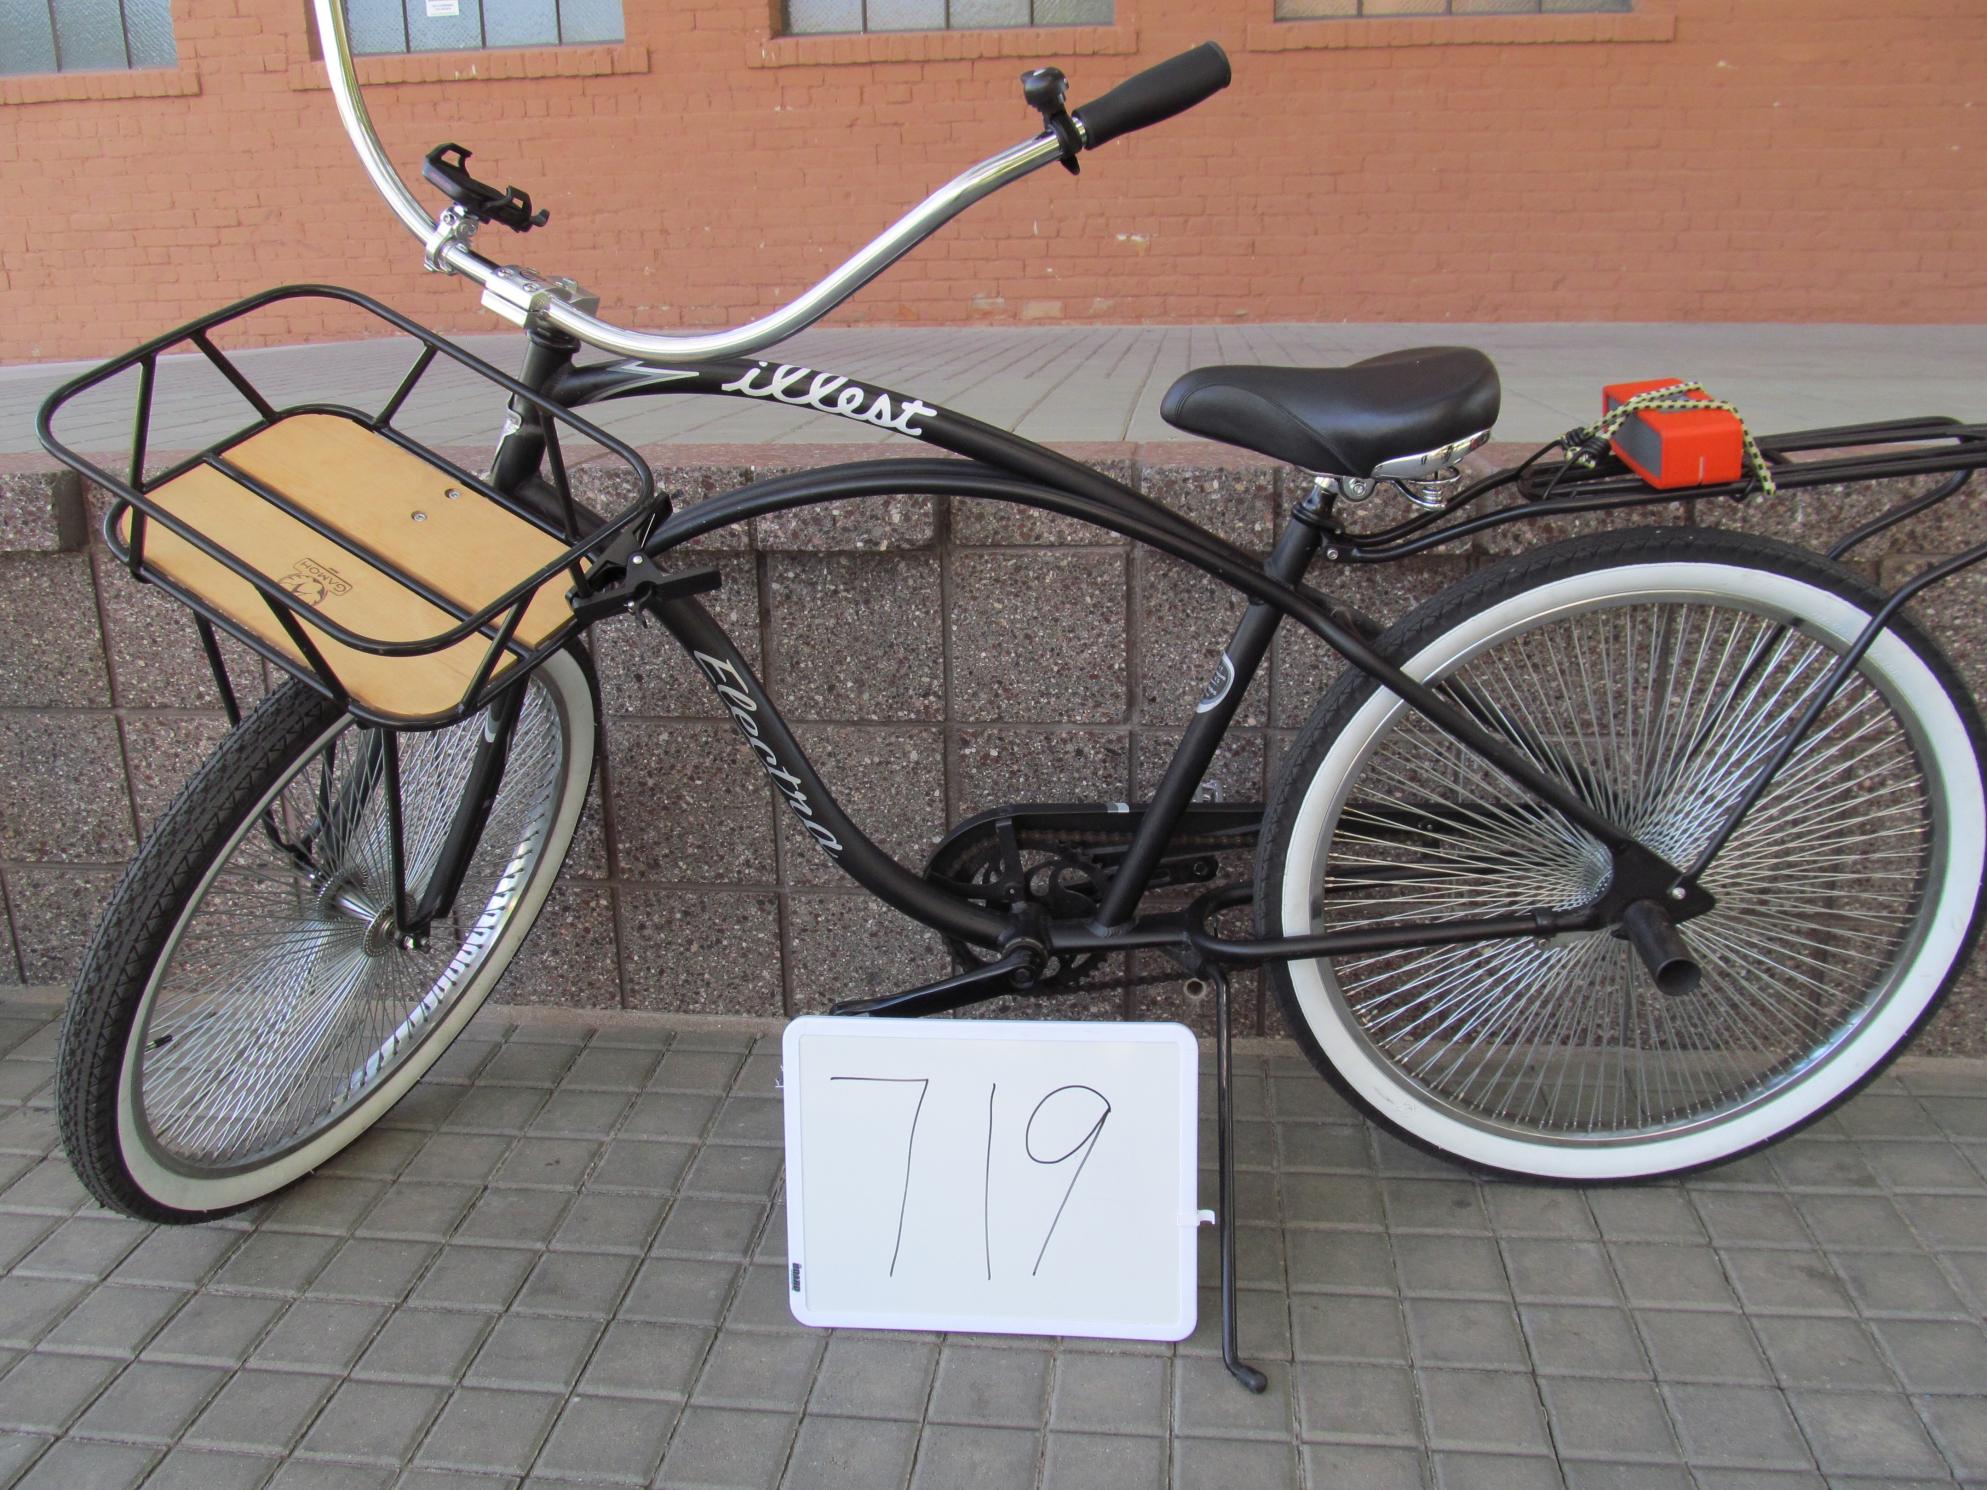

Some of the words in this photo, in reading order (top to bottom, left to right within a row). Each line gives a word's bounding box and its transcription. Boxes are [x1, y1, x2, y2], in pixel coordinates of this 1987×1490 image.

[721, 361, 938, 436] illest
[693, 650, 843, 858] Electra
[830, 1076, 1112, 1281] 719
